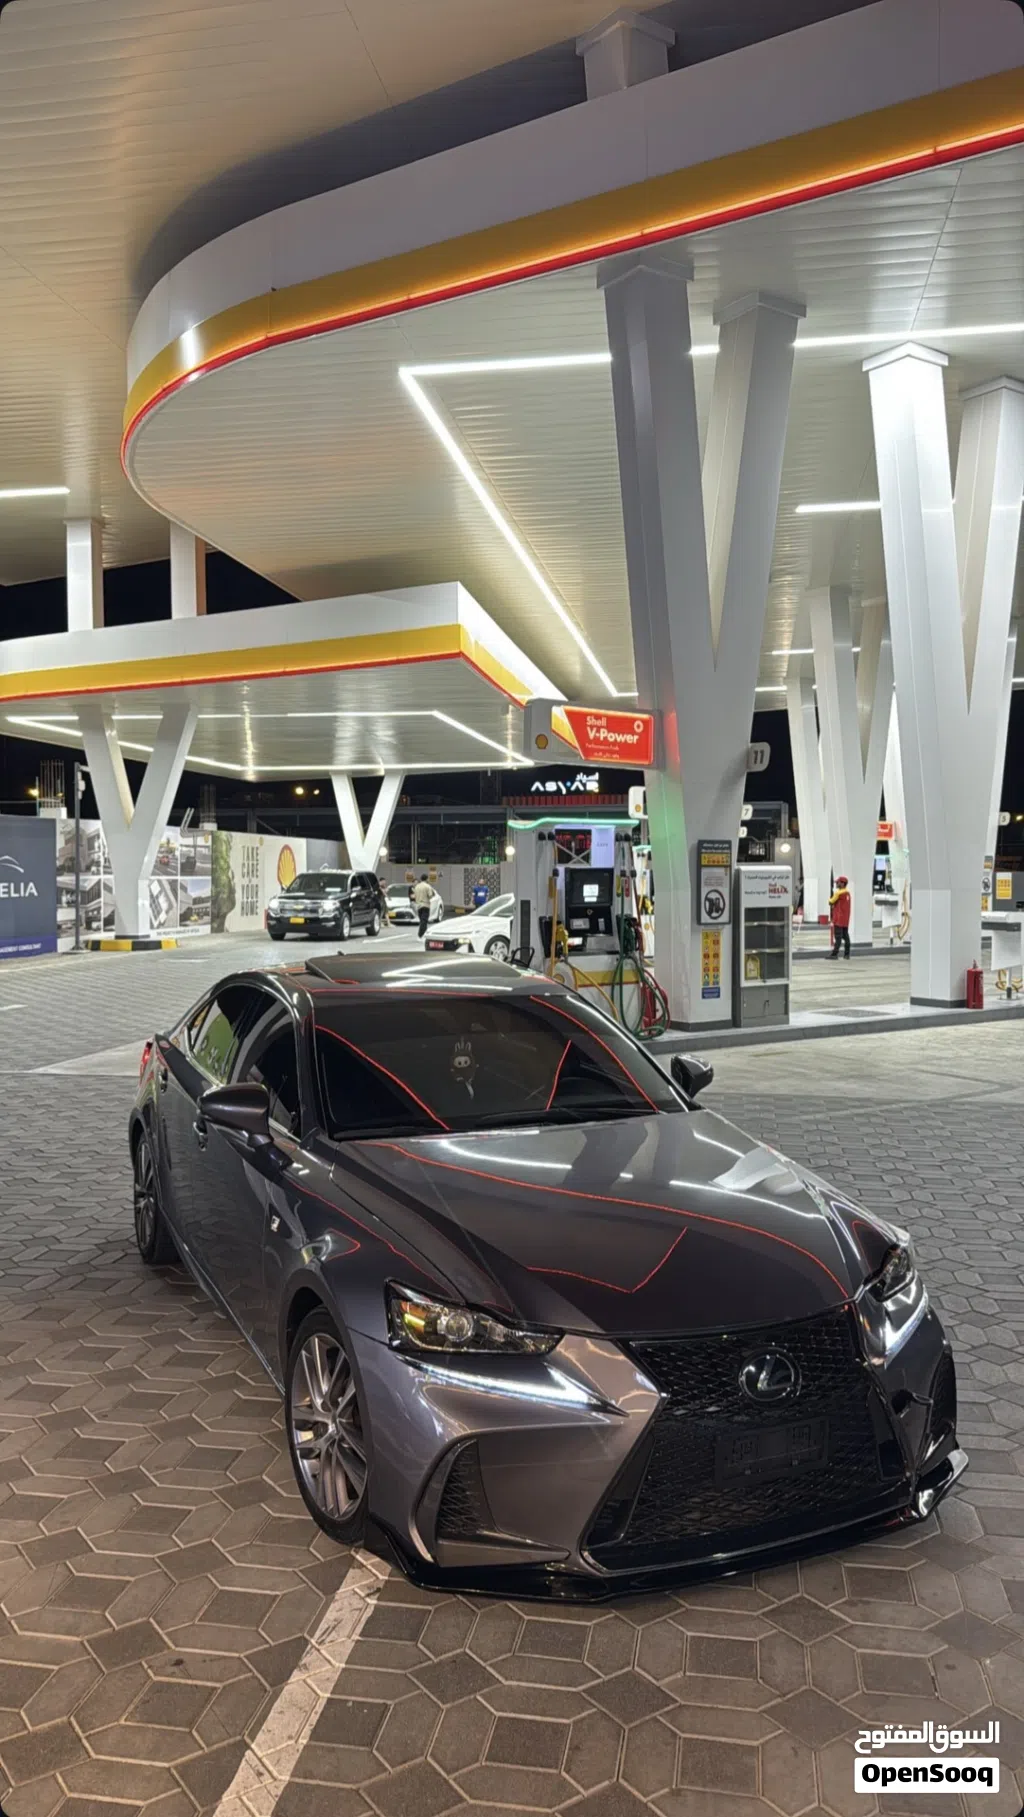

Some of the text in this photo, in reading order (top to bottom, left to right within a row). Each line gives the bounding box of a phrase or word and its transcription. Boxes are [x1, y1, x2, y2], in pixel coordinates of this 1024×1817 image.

[586, 715, 607, 727] Shell
[586, 726, 639, 744] V-Power
[753, 749, 765, 765] 11
[241, 862, 260, 879] CARE
[240, 883, 259, 900] YOUR
[240, 900, 259, 917] HOME
